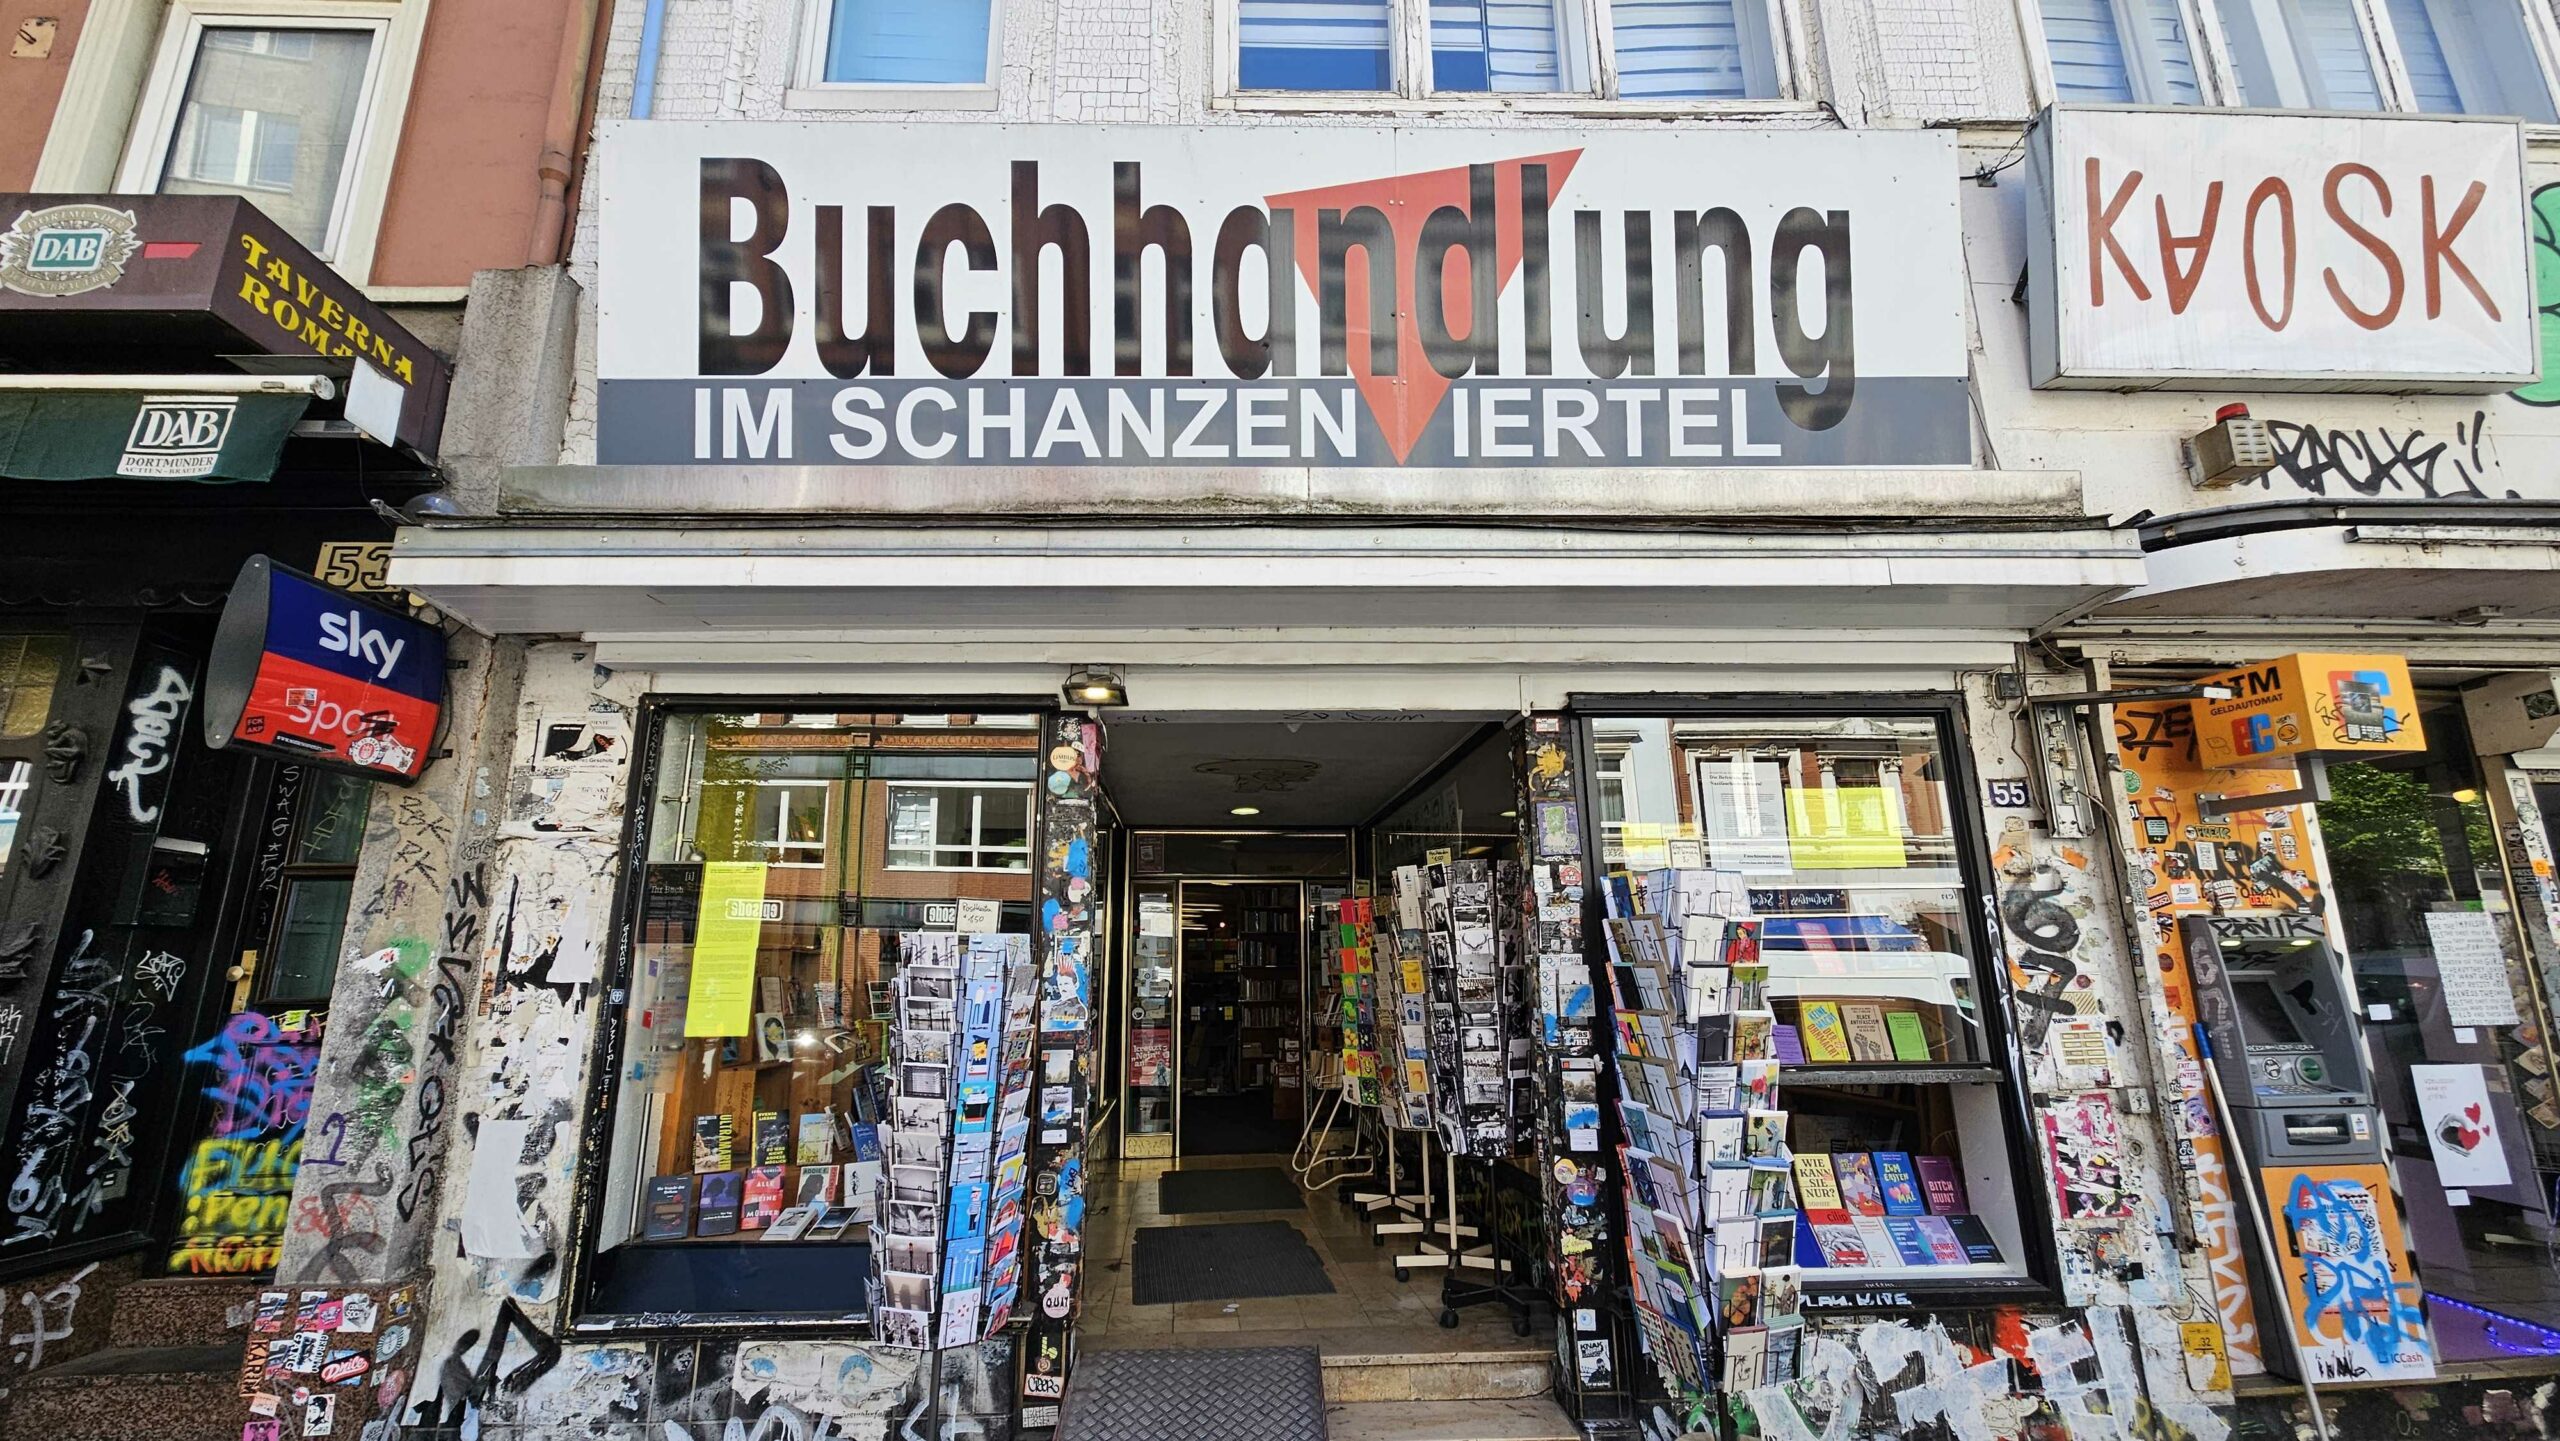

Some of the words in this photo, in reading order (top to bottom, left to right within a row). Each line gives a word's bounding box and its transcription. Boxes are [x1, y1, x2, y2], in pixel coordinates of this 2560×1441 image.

[36, 237, 101, 262] DAB
[698, 157, 1856, 431] Buchhandlung
[240, 233, 415, 385] TAVERNA
[138, 410, 219, 447] DAB
[694, 387, 793, 459] IM
[126, 455, 215, 468] DORTMUNDER
[318, 610, 405, 680] sky
[2210, 692, 2284, 716] GELDAUTOMAT
[1994, 781, 2026, 806] 55
[1801, 1158, 1825, 1168] WIE
[1884, 1163, 1901, 1173] ZUM
[1800, 1168, 1832, 1178] KANN
[1805, 1187, 1836, 1198] NUR?
[1809, 1178, 1829, 1188] SIE
[1928, 1180, 1954, 1191] BITCH
[1931, 1192, 1955, 1203] HUNT
[1827, 1210, 1848, 1224] cilip
[285, 1332, 303, 1372] GANG
